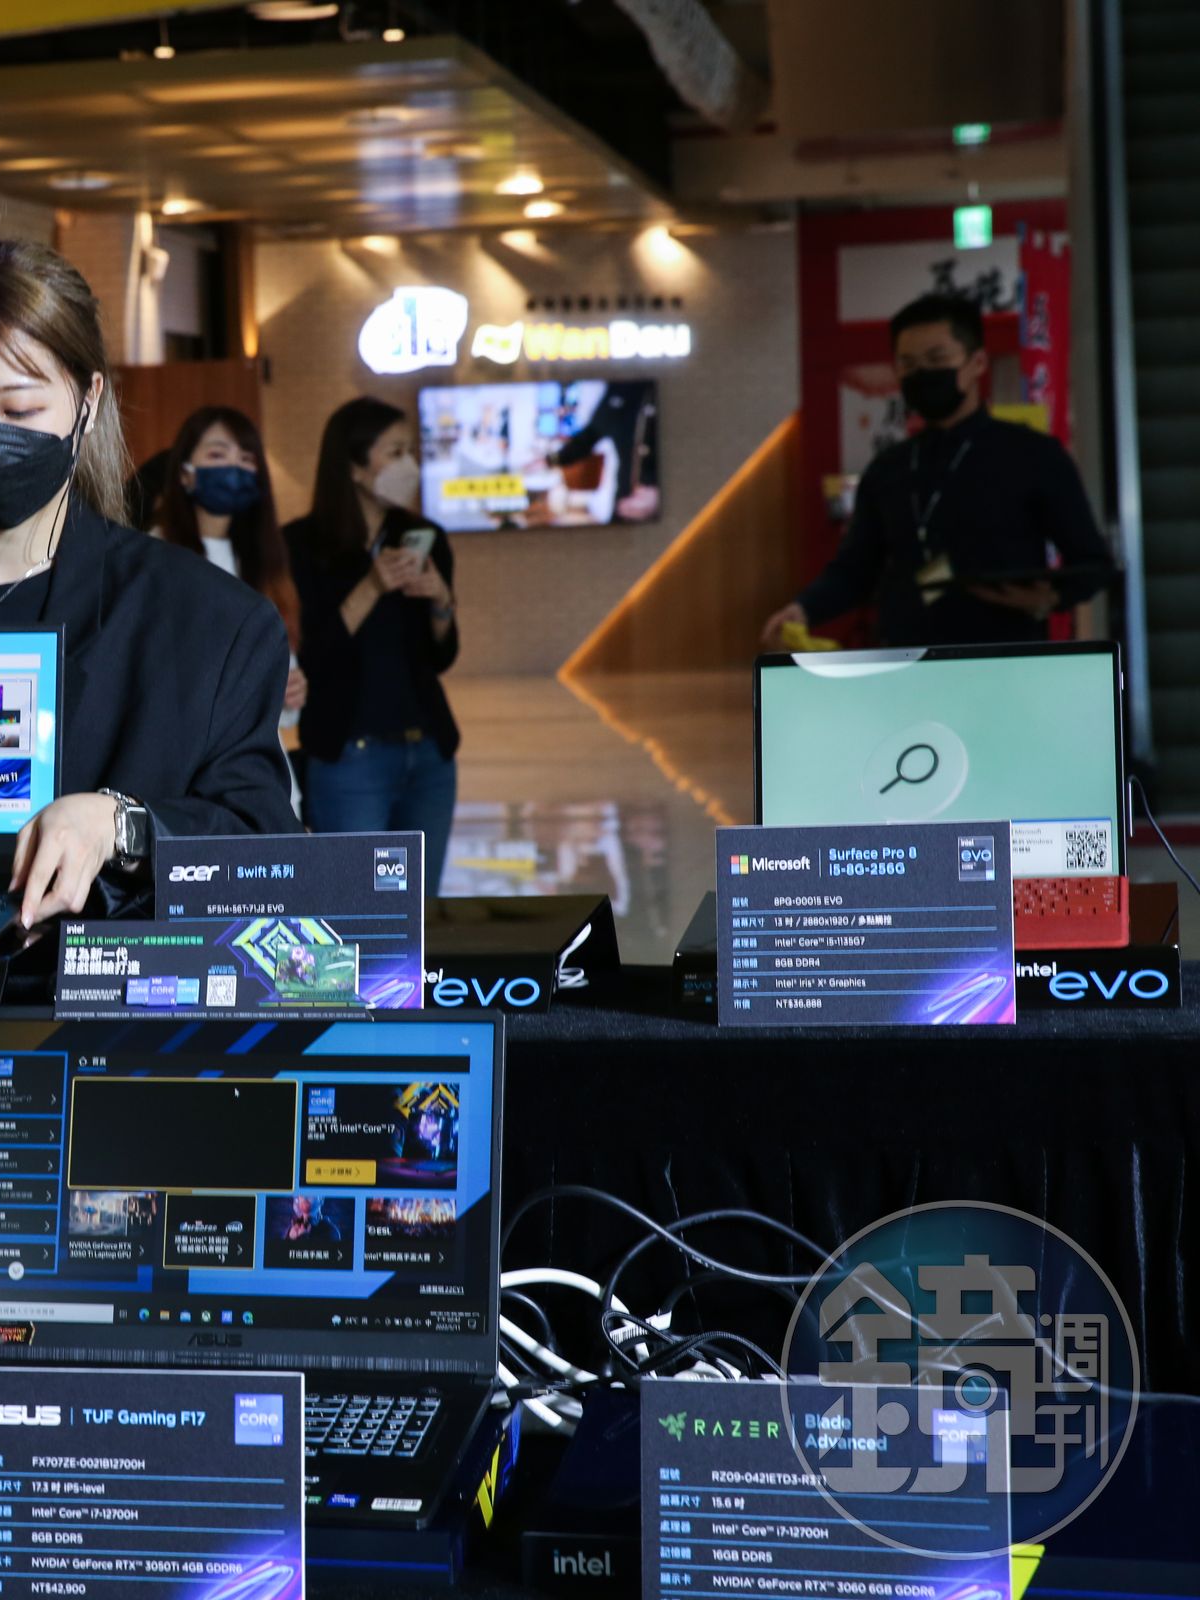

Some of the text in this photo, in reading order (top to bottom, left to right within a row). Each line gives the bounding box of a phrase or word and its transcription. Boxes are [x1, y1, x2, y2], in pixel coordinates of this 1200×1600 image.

[10, 772, 18, 783] 11
[752, 856, 811, 871] Microsoft
[829, 848, 878, 861] Surface
[882, 847, 905, 859] Pro
[961, 850, 992, 862] evo
[169, 863, 295, 882] acer Swift 系列
[376, 863, 405, 876] evo
[824, 895, 843, 906] EVO
[267, 903, 284, 914] EVO
[775, 958, 793, 968] 8GB
[795, 958, 821, 968] DDR4
[1016, 962, 1057, 978] intel
[424, 968, 443, 984] tel
[829, 977, 866, 989] Graphics
[432, 977, 540, 1007] evo
[1048, 969, 1169, 1000] evo
[68, 1241, 92, 1250] NVIDIA
[187, 1332, 243, 1347] ASUS
[82, 1408, 114, 1423] TUF
[118, 1409, 177, 1429] Gaming
[181, 1410, 207, 1426] F17
[804, 1413, 851, 1431] Blade
[694, 1418, 781, 1439] RAZER
[804, 1433, 888, 1451] Advanced
[31, 1481, 49, 1494] 17.3
[712, 1496, 732, 1509] 15.6
[90, 1508, 139, 1521] i7-12700H
[31, 1531, 52, 1543] 8GB
[54, 1532, 84, 1544] DDR5
[776, 1526, 829, 1540] i7-12700H
[553, 1549, 612, 1577] intel
[712, 1549, 739, 1562] 16GB
[742, 1551, 773, 1564] DDR5
[72, 1558, 113, 1570] GeForce
[182, 1560, 204, 1573] 4GB
[757, 1577, 802, 1591] GeForce
[837, 1581, 866, 1595] 3060
[869, 1583, 892, 1596] 6GB
[895, 1585, 936, 1598] GDDR6
